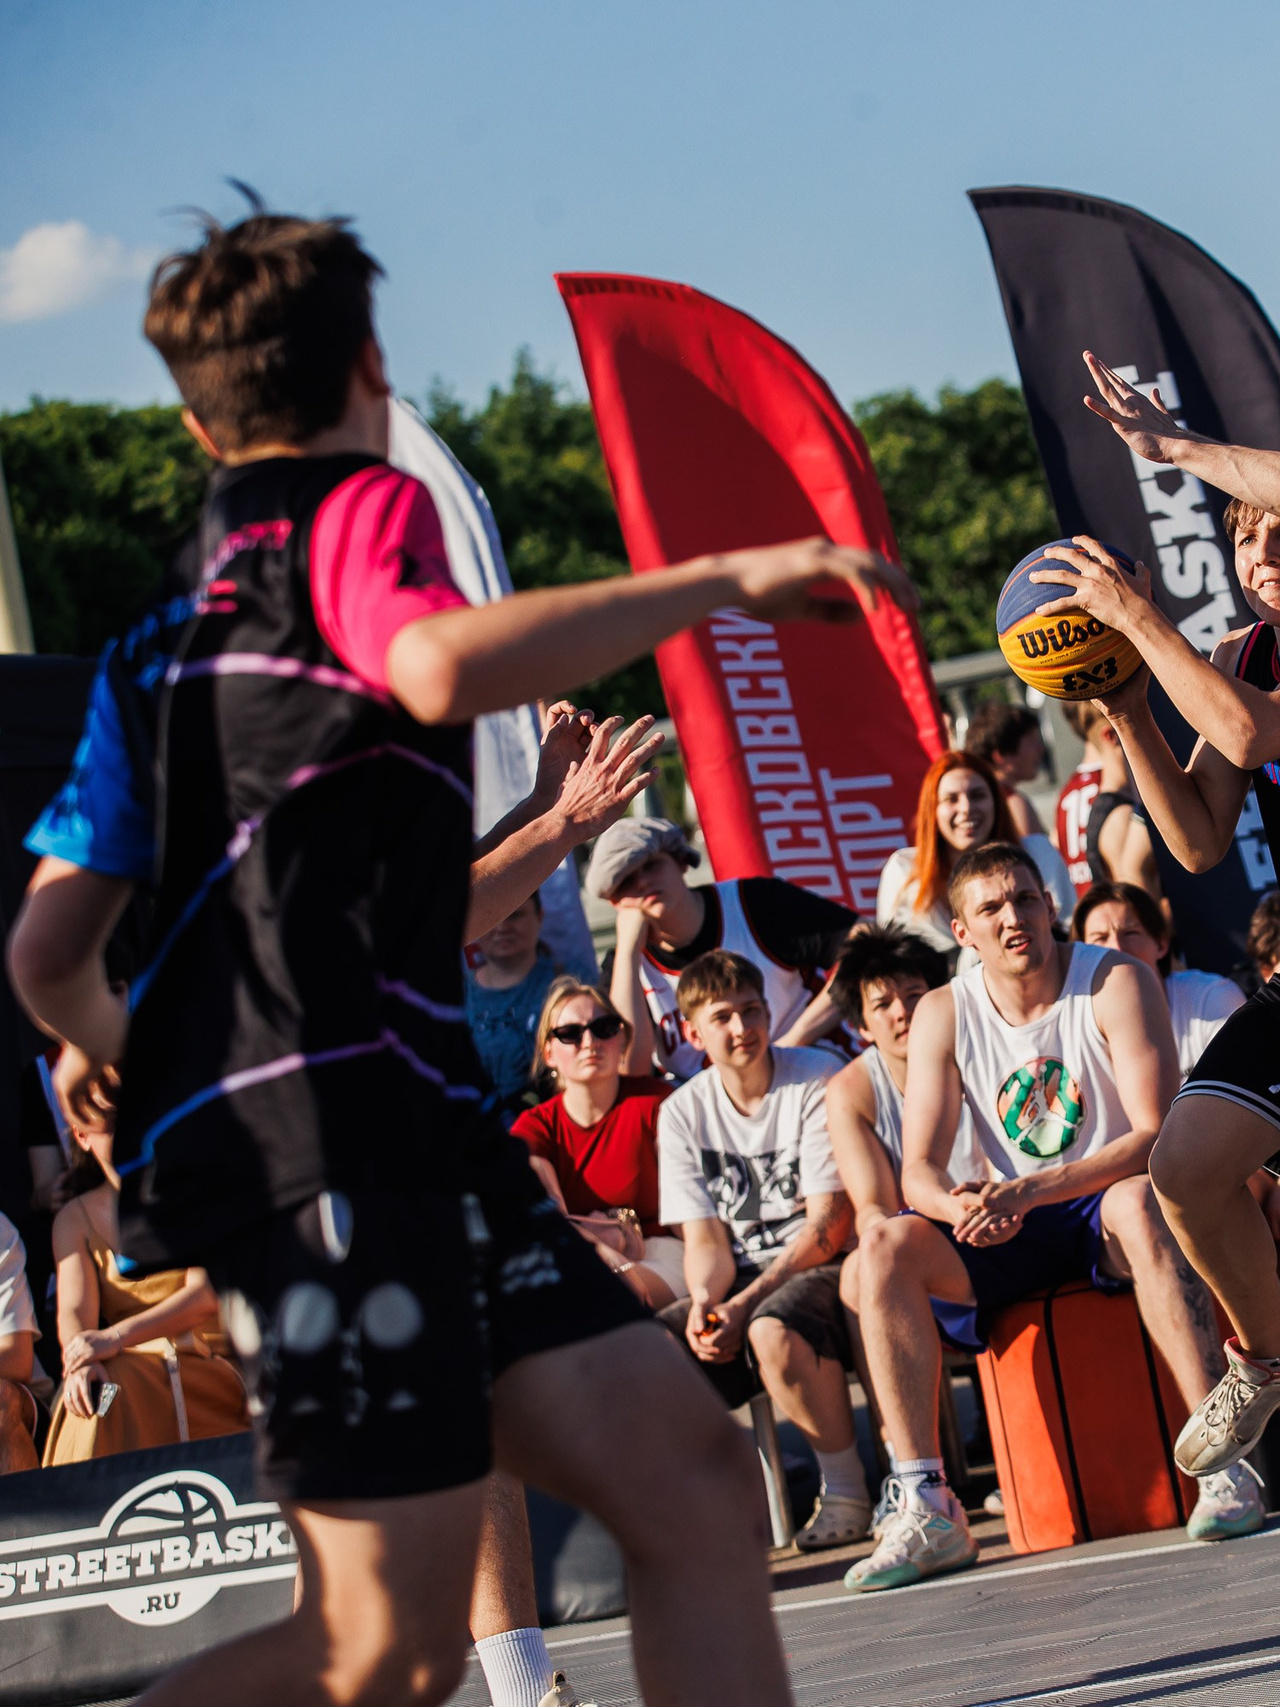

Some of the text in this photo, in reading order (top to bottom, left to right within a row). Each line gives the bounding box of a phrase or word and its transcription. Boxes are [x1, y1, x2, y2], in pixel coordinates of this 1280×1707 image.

[1017, 619, 1113, 659] Wilso
[0, 1519, 298, 1600] STREETBASK
[140, 1591, 182, 1615] .RU
